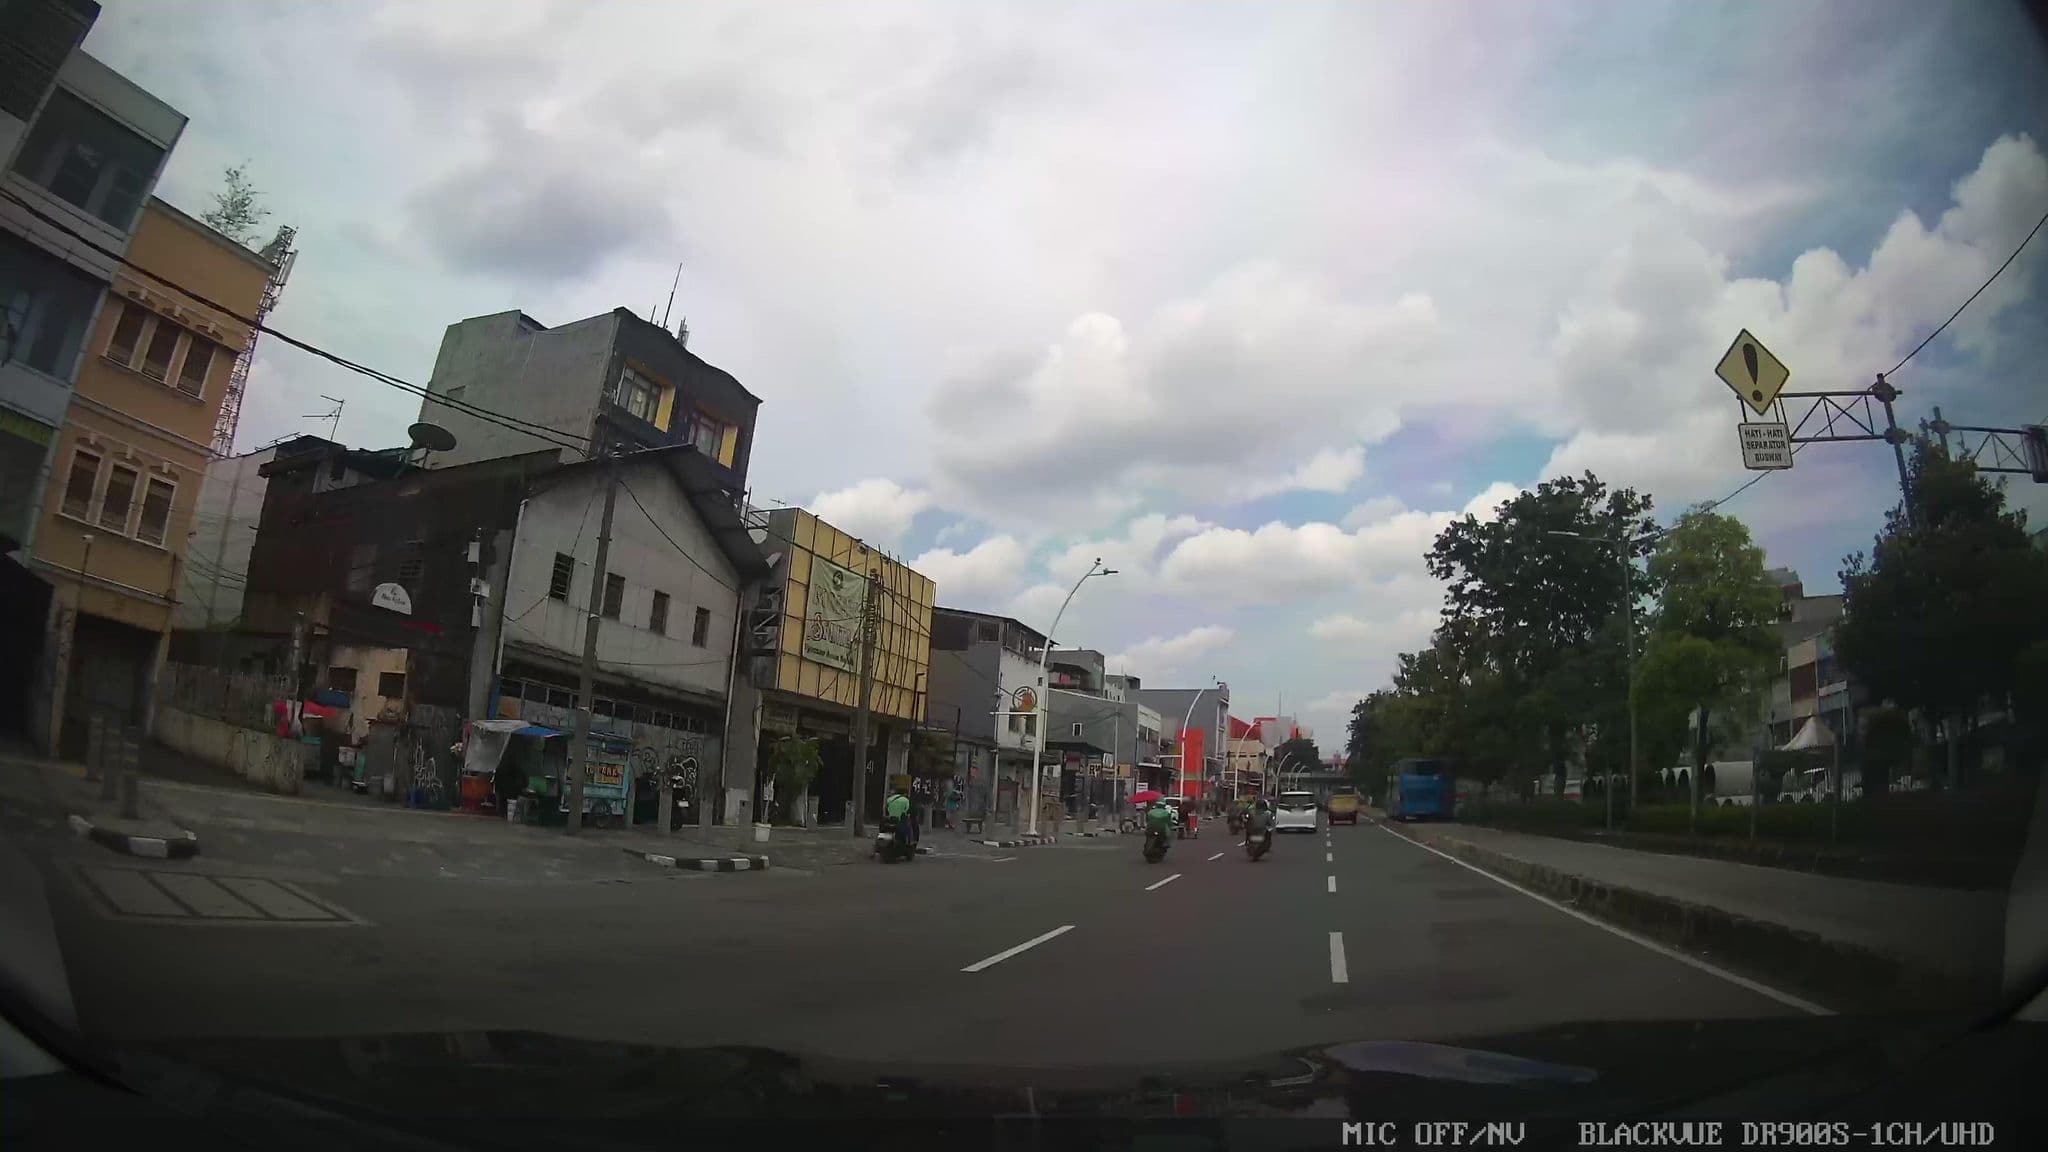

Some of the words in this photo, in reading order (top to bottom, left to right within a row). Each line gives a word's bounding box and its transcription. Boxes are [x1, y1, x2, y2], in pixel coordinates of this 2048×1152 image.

[1745, 429, 1762, 438] HATI
[1767, 429, 1783, 438] HATI
[1746, 440, 1786, 450] SEPARATOR
[1754, 453, 1782, 462] BUSWAY
